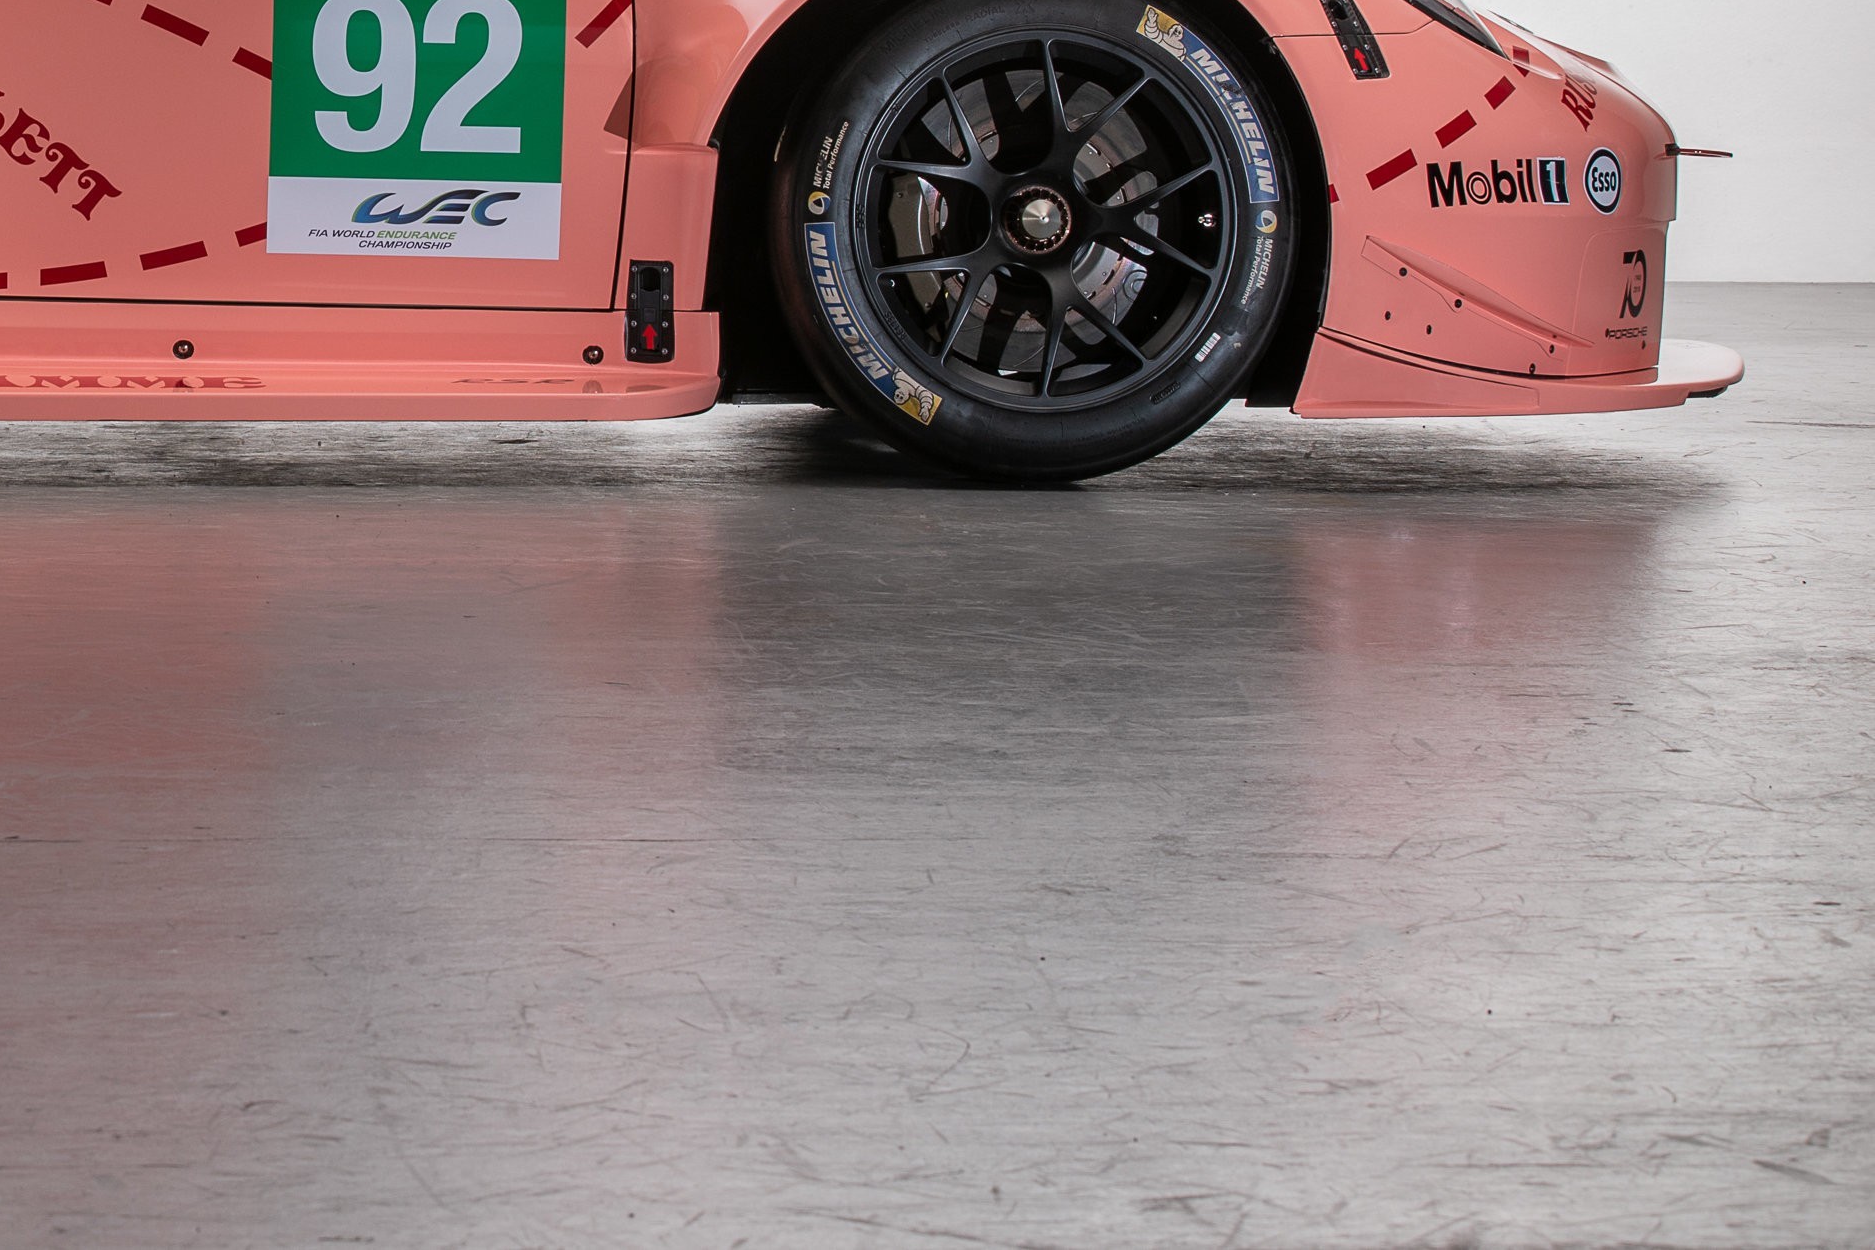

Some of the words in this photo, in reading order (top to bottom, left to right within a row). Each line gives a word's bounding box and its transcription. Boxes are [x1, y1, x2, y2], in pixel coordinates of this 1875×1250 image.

[826, 120, 852, 170] Performance
[1426, 158, 1538, 208] Mobil
[351, 188, 522, 227] WEC
[308, 228, 329, 238] FIA
[331, 229, 376, 239] WORLD
[376, 230, 458, 241] ENDURANCE
[358, 239, 453, 251] CHAMPIONSHIP
[1240, 258, 1260, 305] Performance
[1256, 237, 1273, 289] MICHELIN
[809, 230, 889, 380] MICHELIN
